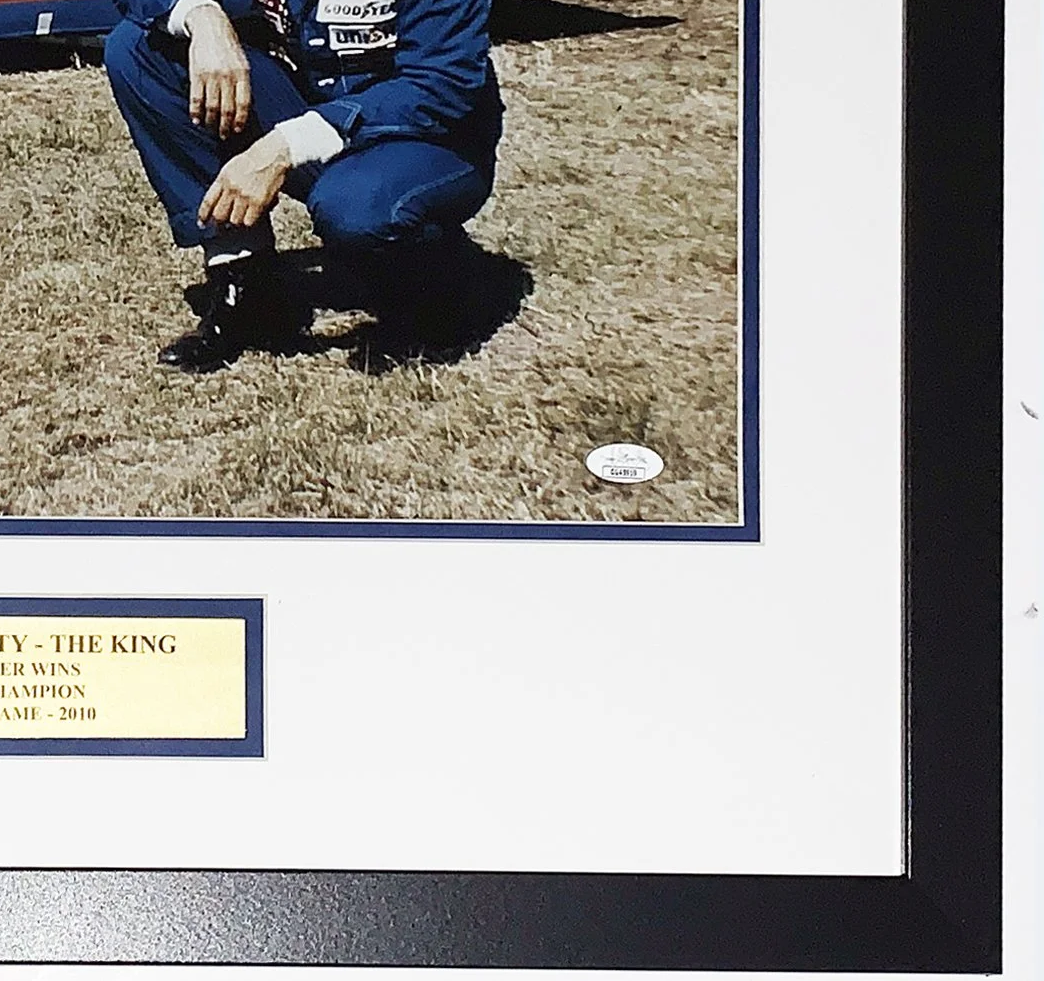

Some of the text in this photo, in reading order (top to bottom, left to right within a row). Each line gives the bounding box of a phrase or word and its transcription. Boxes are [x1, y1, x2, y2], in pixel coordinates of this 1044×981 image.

[50, 634, 103, 654] THE
[111, 634, 176, 654] KING
[30, 662, 82, 677] WINS
[59, 706, 97, 721] 2010
